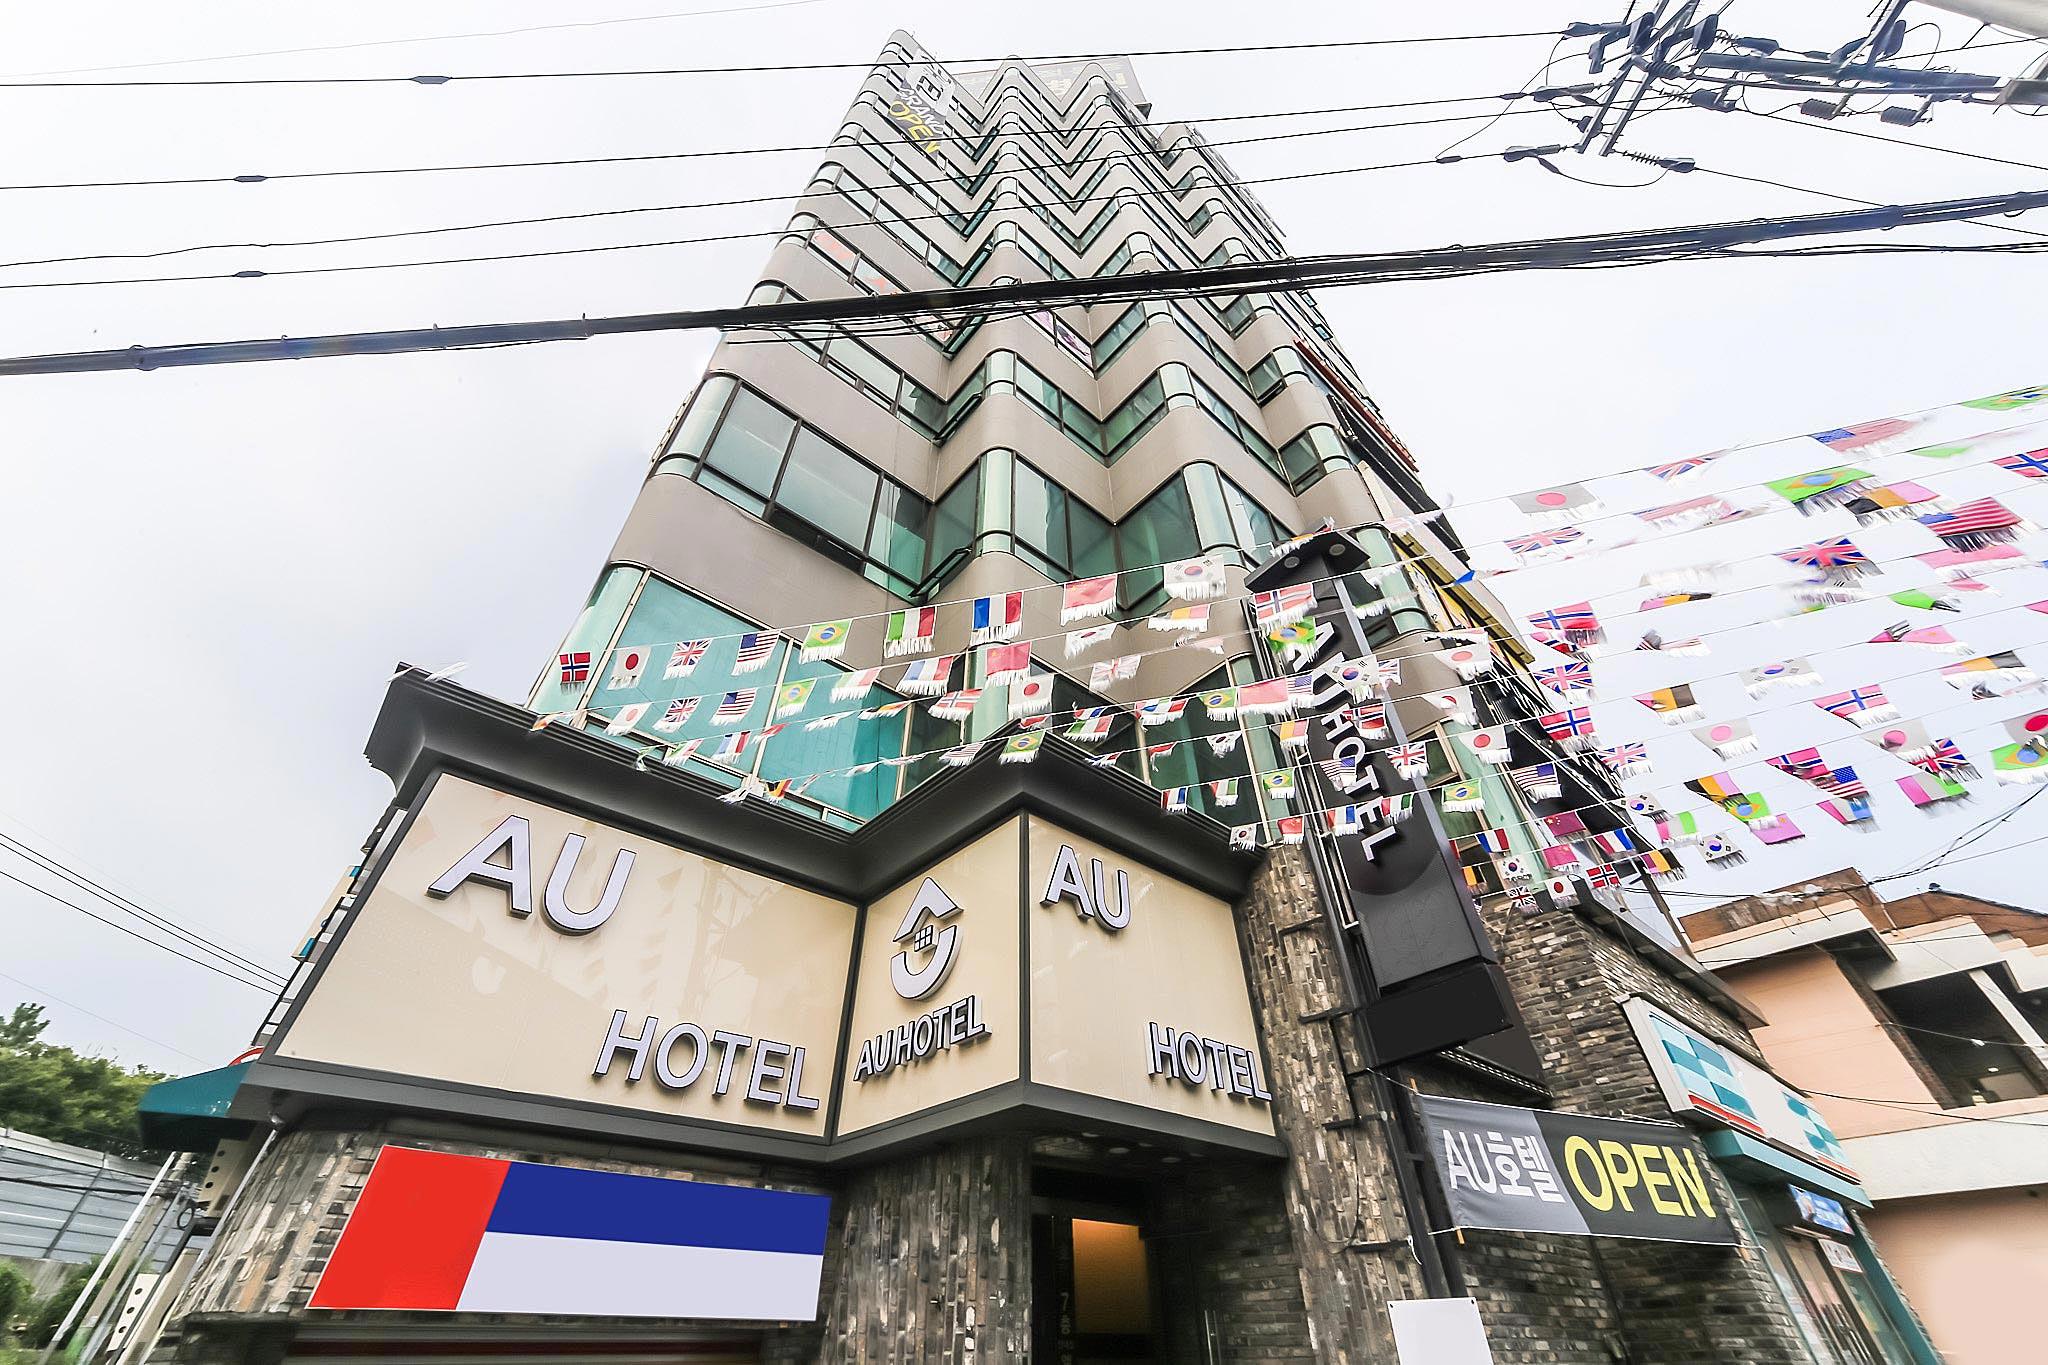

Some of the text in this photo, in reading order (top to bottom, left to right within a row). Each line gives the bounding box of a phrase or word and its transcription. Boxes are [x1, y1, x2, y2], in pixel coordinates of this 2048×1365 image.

[889, 101, 940, 154] OPEN
[1320, 703, 1398, 863] HOTEL
[425, 815, 637, 936] AU
[1040, 844, 1132, 931] AU
[592, 1009, 820, 1113] HOTEL
[1146, 1021, 1273, 1102] HOTEL
[1442, 1129, 1717, 1219] AU호텔 OPEN
